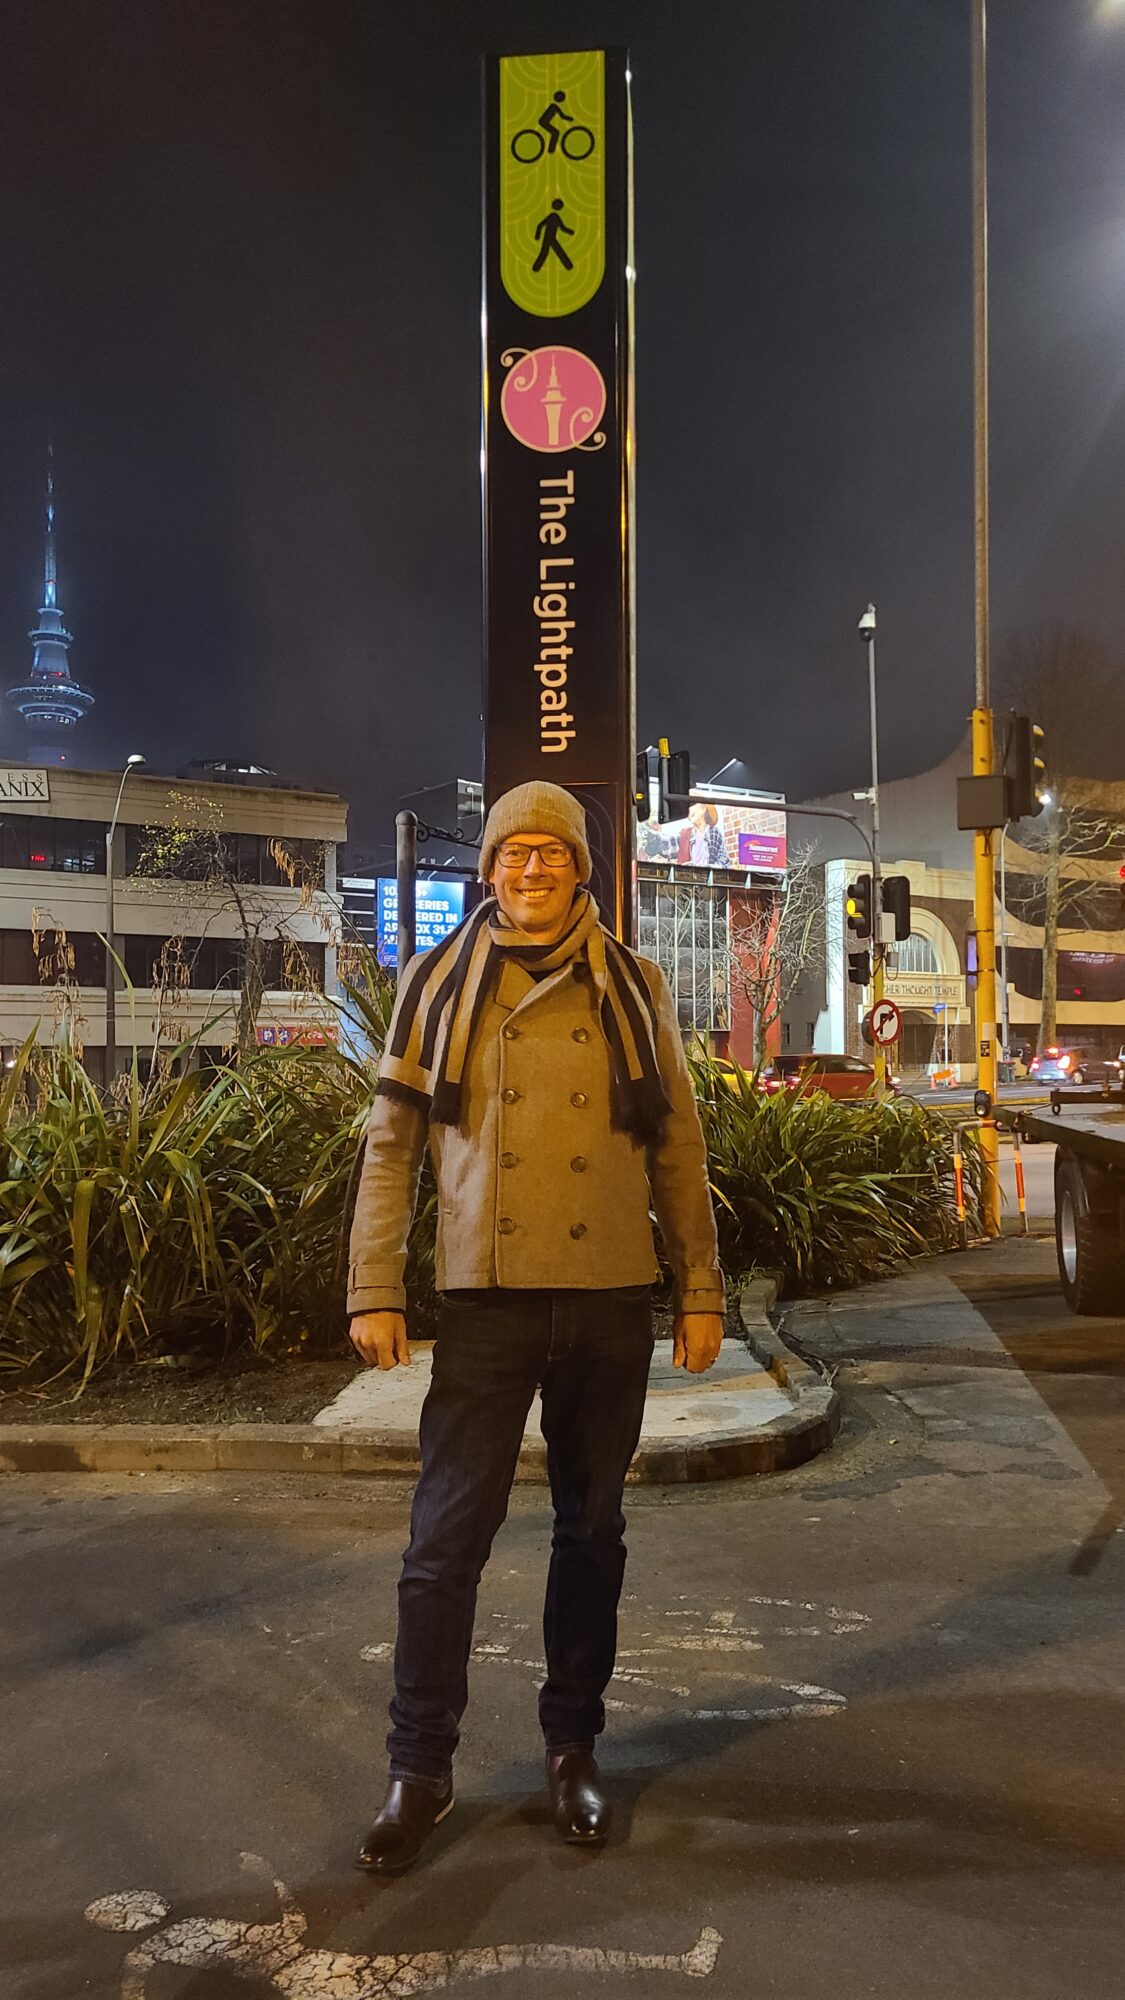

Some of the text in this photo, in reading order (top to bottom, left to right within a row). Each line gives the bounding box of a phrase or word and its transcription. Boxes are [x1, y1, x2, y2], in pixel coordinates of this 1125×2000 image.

[533, 469, 576, 753] The Lightpath
[383, 910, 458, 923] DEERED IN
[384, 922, 431, 934] APOX
[883, 984, 957, 996] HER THOUGHT TEMPLE
